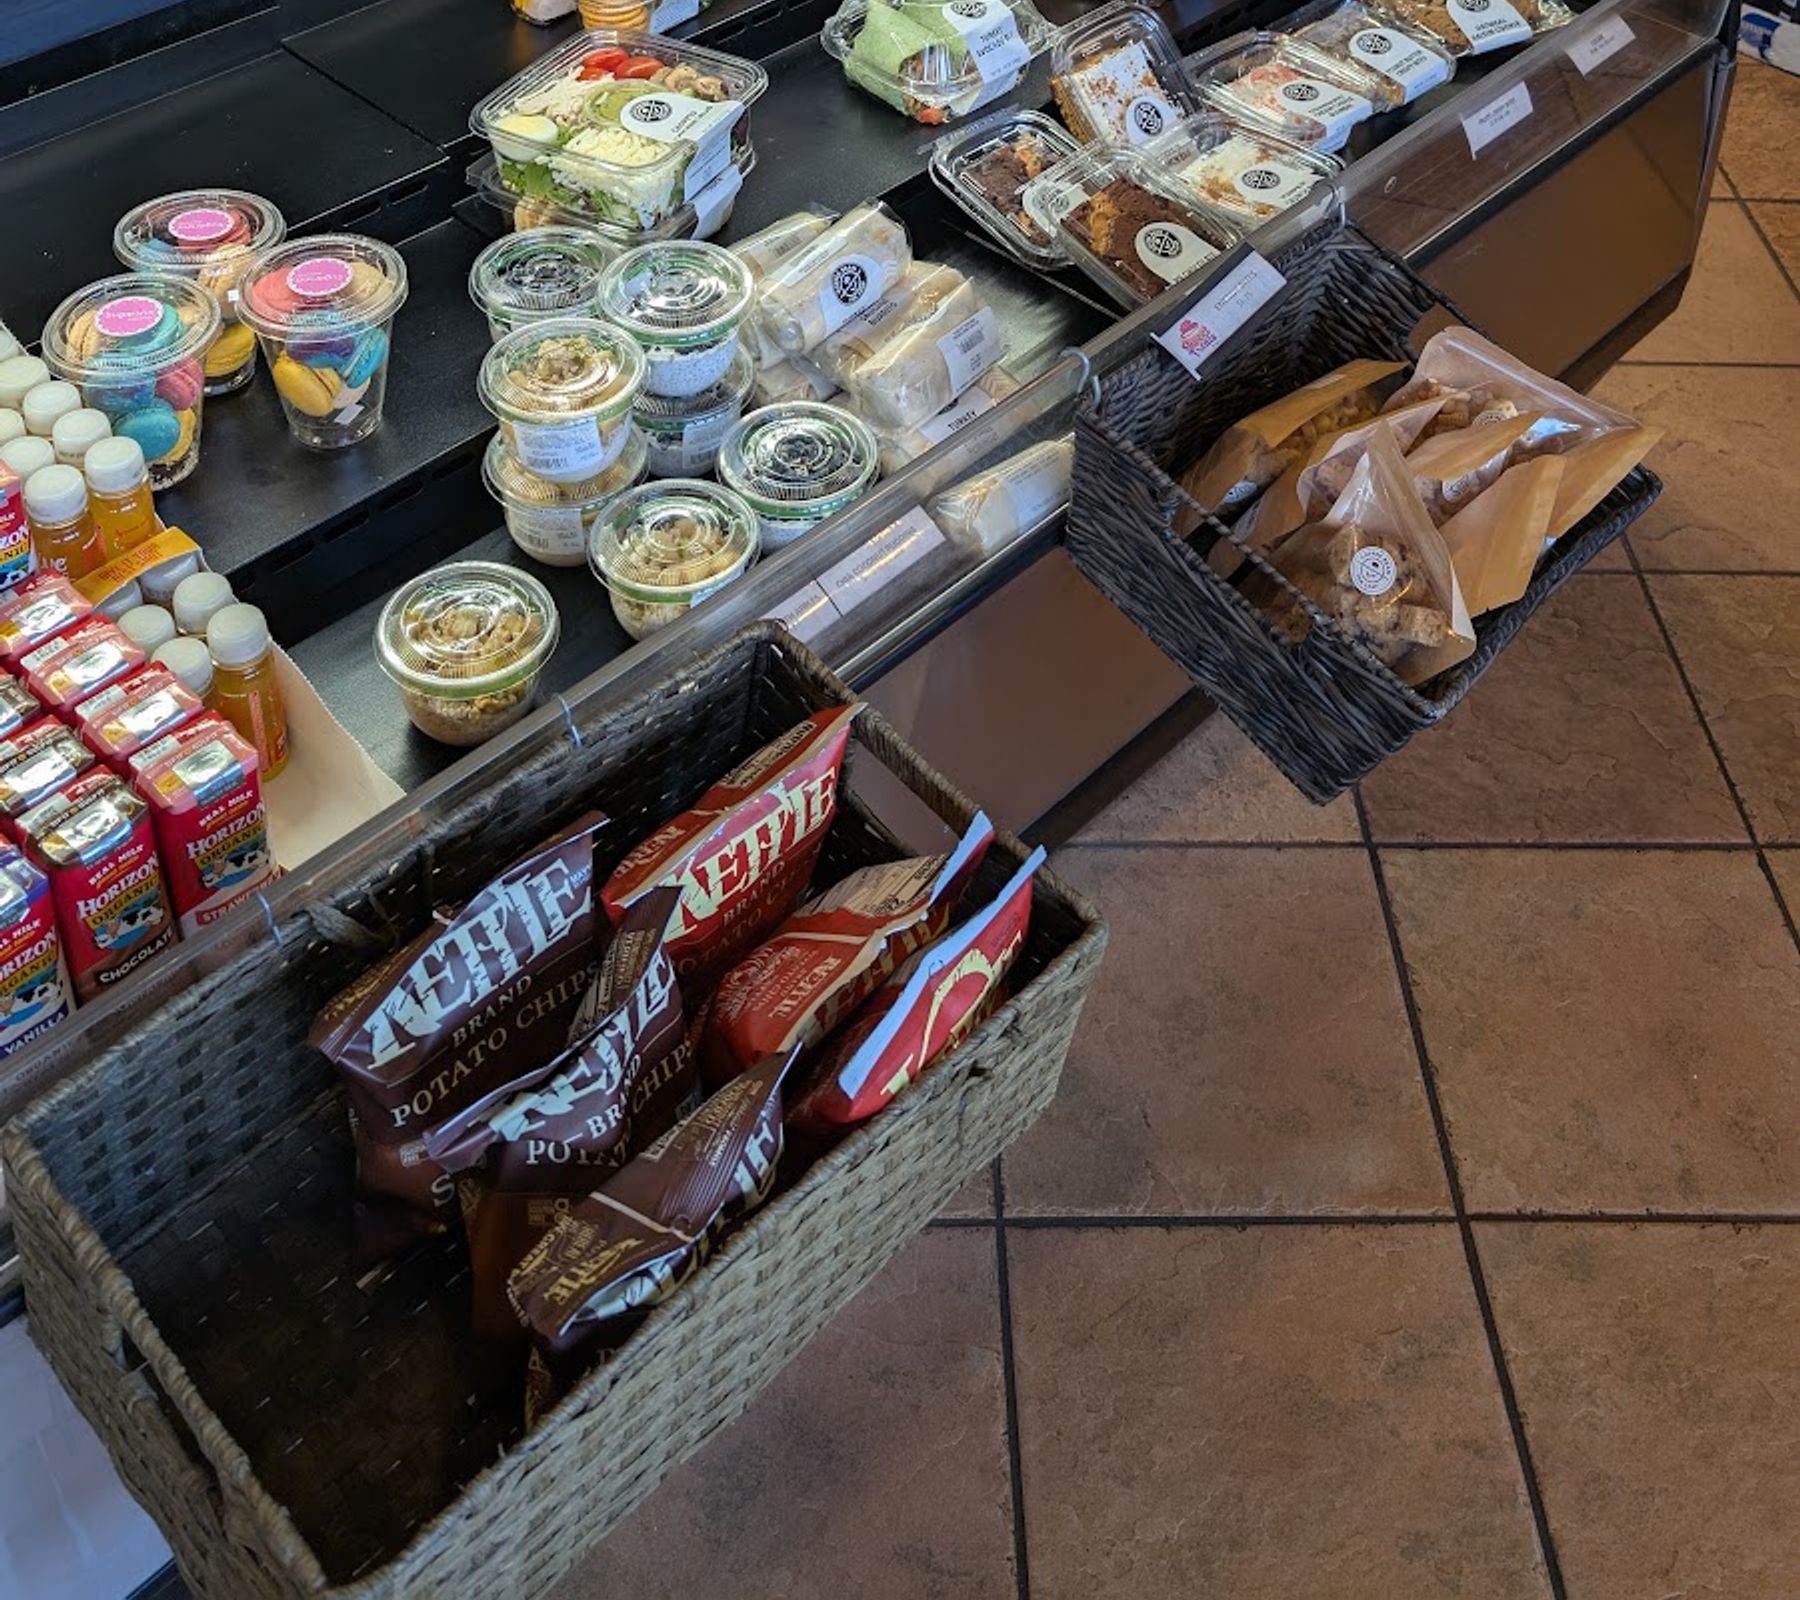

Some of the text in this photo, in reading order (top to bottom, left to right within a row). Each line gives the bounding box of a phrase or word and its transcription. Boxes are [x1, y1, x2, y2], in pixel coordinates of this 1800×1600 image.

[186, 802, 265, 860] HORIZON
[200, 790, 254, 828] REAL MILK
[76, 850, 160, 920] HORIZON
[88, 844, 144, 886] REAL MILK
[723, 858, 786, 924] BRAND
[12, 918, 42, 939] MILK
[367, 857, 593, 1071] KETTLE
[4, 1011, 66, 1056] VANILLA
[452, 974, 533, 1049] BRAND
[389, 960, 601, 1129] POTATO CHIPS
